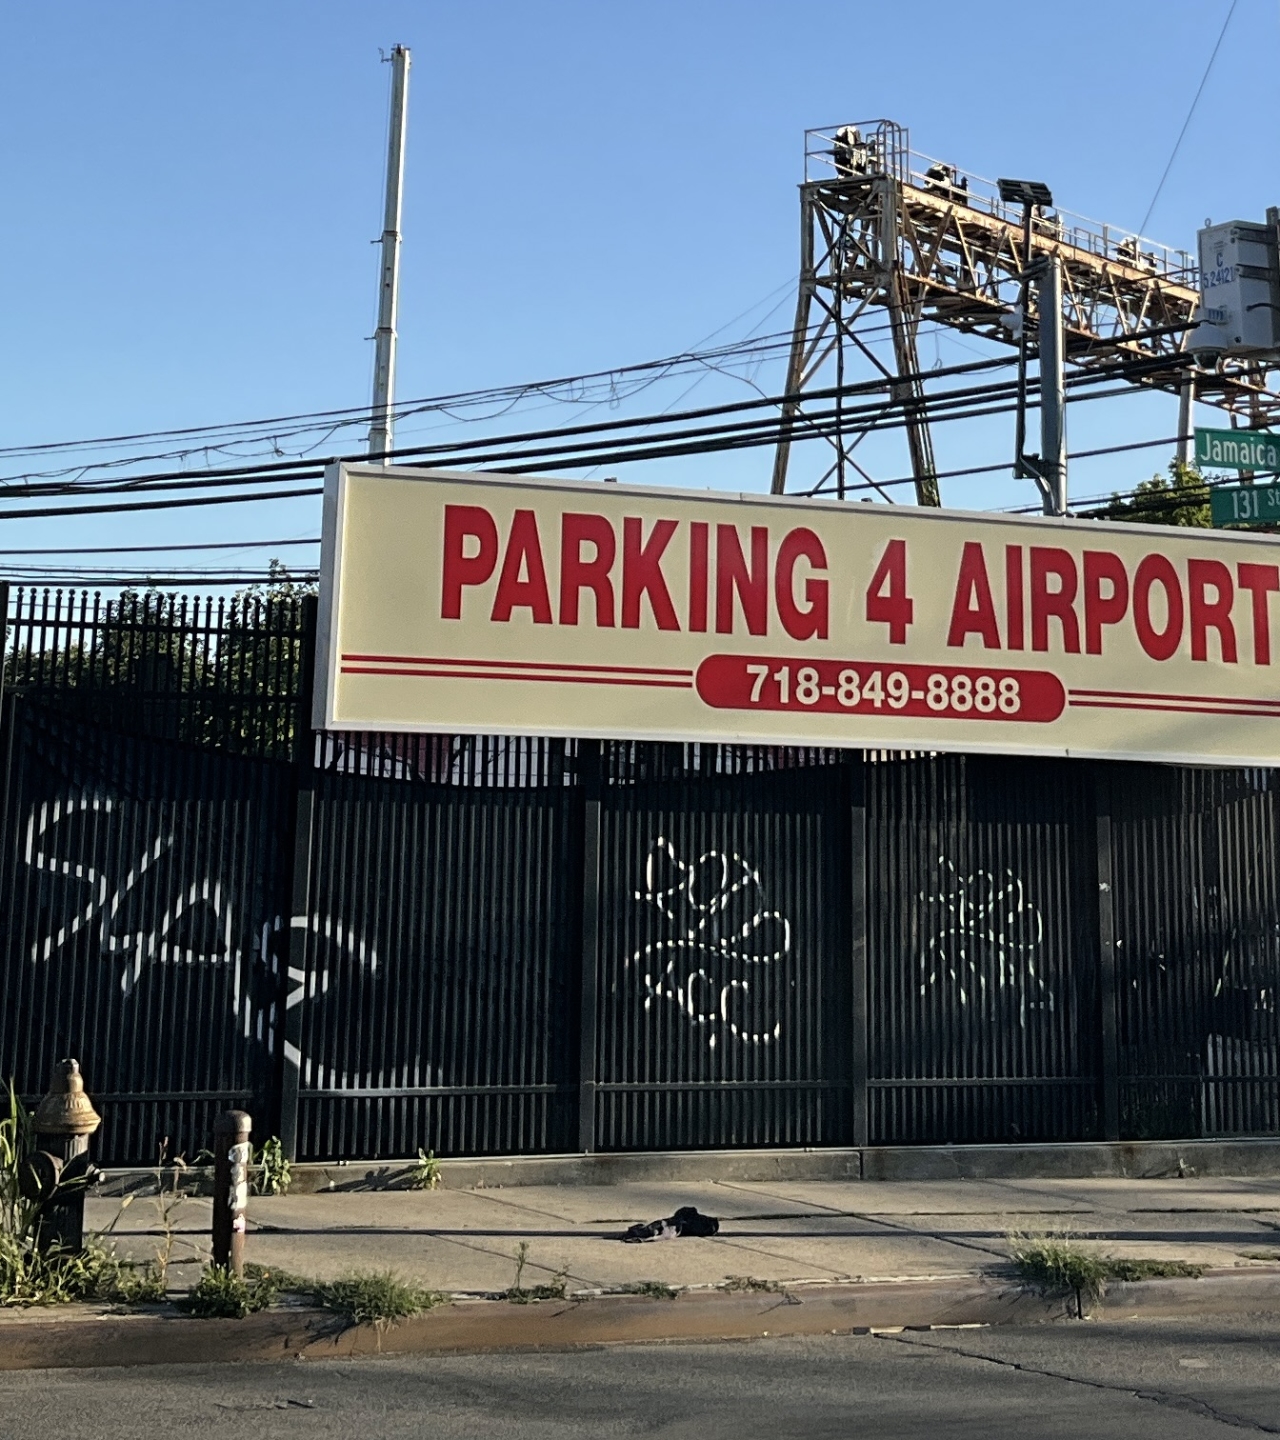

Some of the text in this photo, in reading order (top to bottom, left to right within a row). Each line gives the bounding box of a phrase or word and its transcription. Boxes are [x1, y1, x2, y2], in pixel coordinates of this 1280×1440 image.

[1201, 433, 1277, 467] Jamaica
[1231, 489, 1280, 519] 131 St
[440, 504, 1280, 666] PARKING 4 AIRPORT
[746, 663, 1020, 716] 718-849-8888
